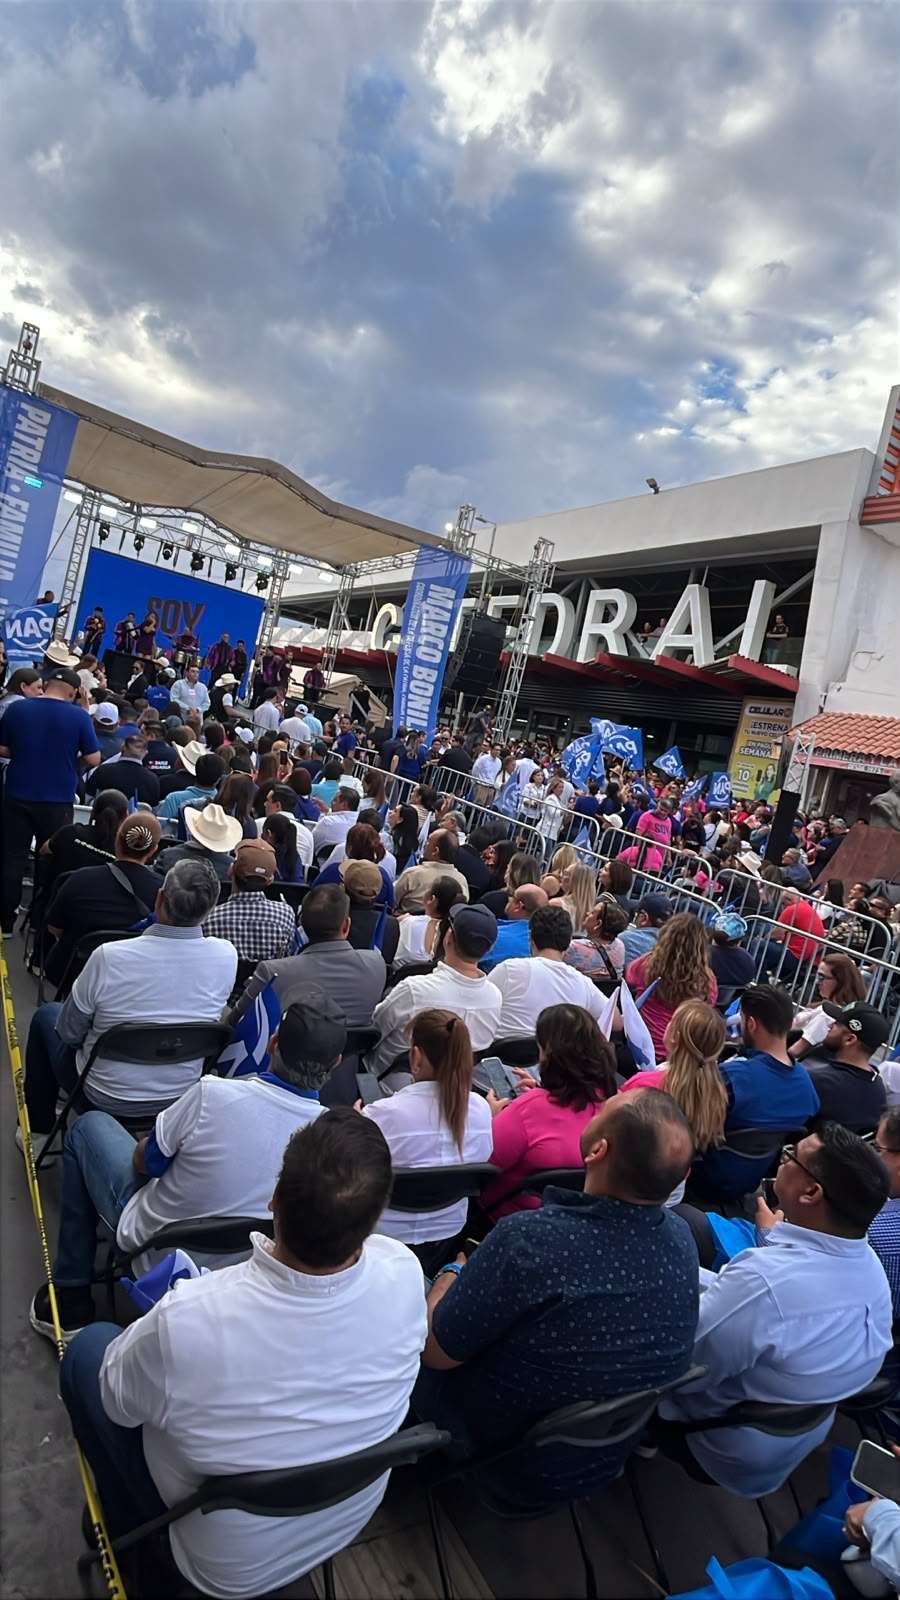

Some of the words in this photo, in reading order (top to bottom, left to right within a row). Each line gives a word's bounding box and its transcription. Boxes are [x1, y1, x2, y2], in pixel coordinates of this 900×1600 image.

[5, 402, 51, 480] PATRIA
[370, 579, 798, 679] CTEDRAL
[416, 584, 456, 664] MARCO
[406, 665, 438, 732] BONIL
[737, 769, 751, 781] 10
[740, 747, 772, 758] SEMANA
